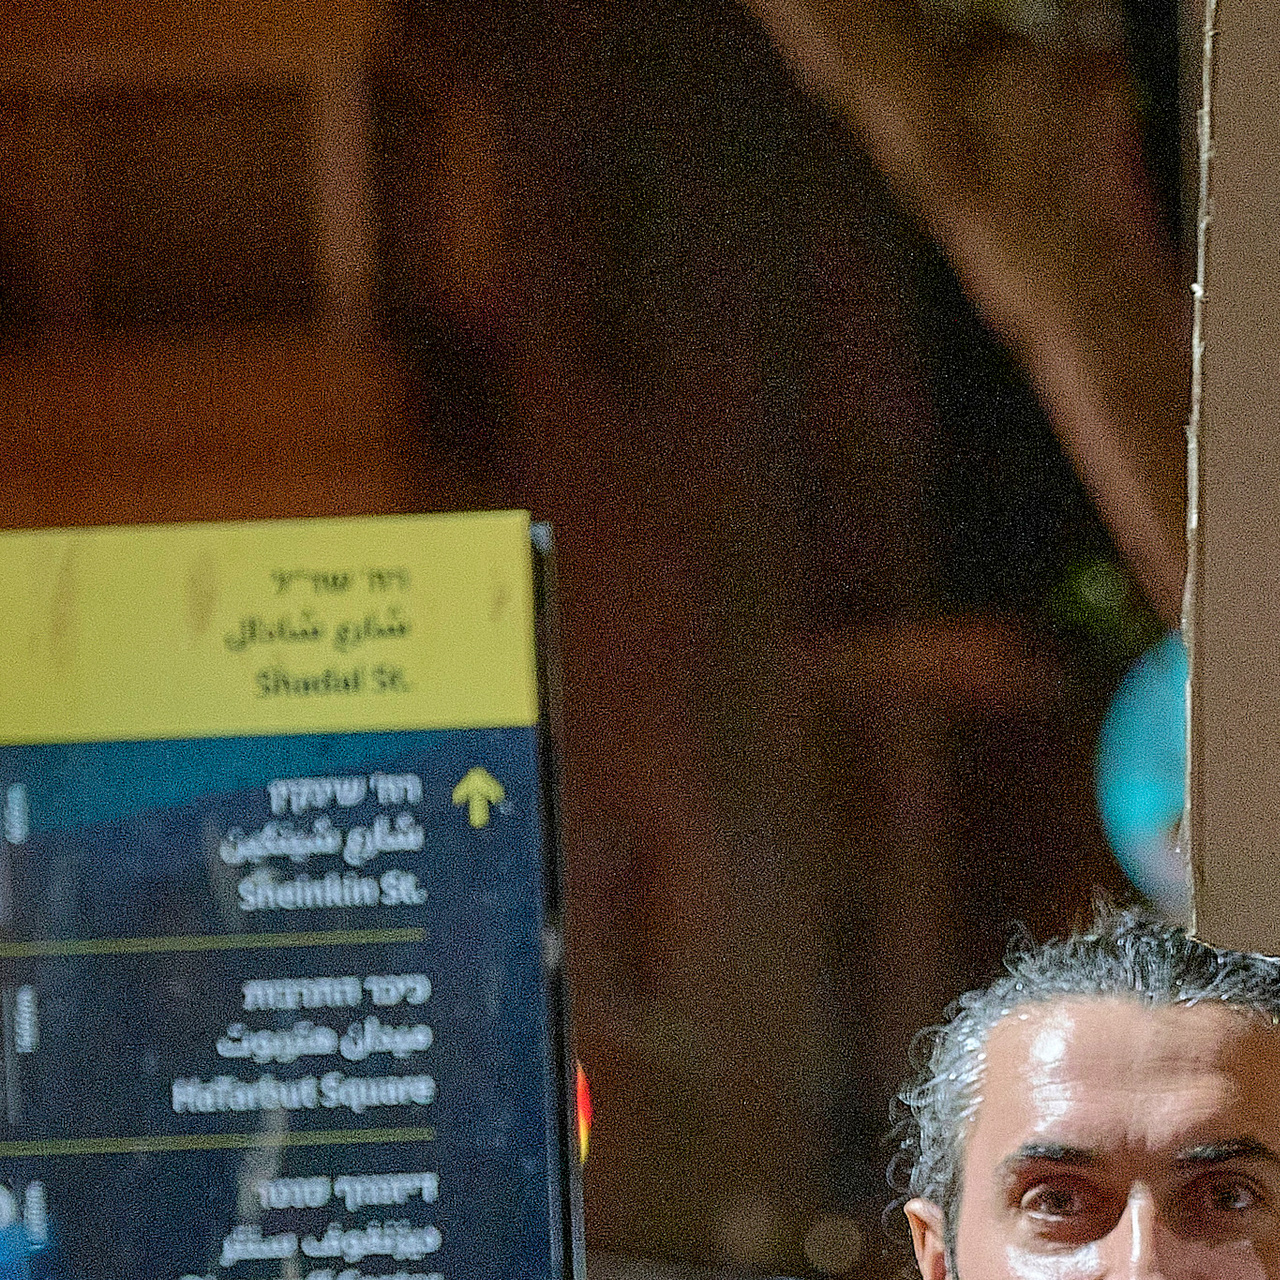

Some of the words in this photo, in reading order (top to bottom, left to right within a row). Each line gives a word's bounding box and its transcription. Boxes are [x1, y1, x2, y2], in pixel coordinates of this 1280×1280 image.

[253, 662, 361, 699] Shadal
[238, 872, 378, 911] Sheinkin
[320, 1071, 437, 1114] Square
